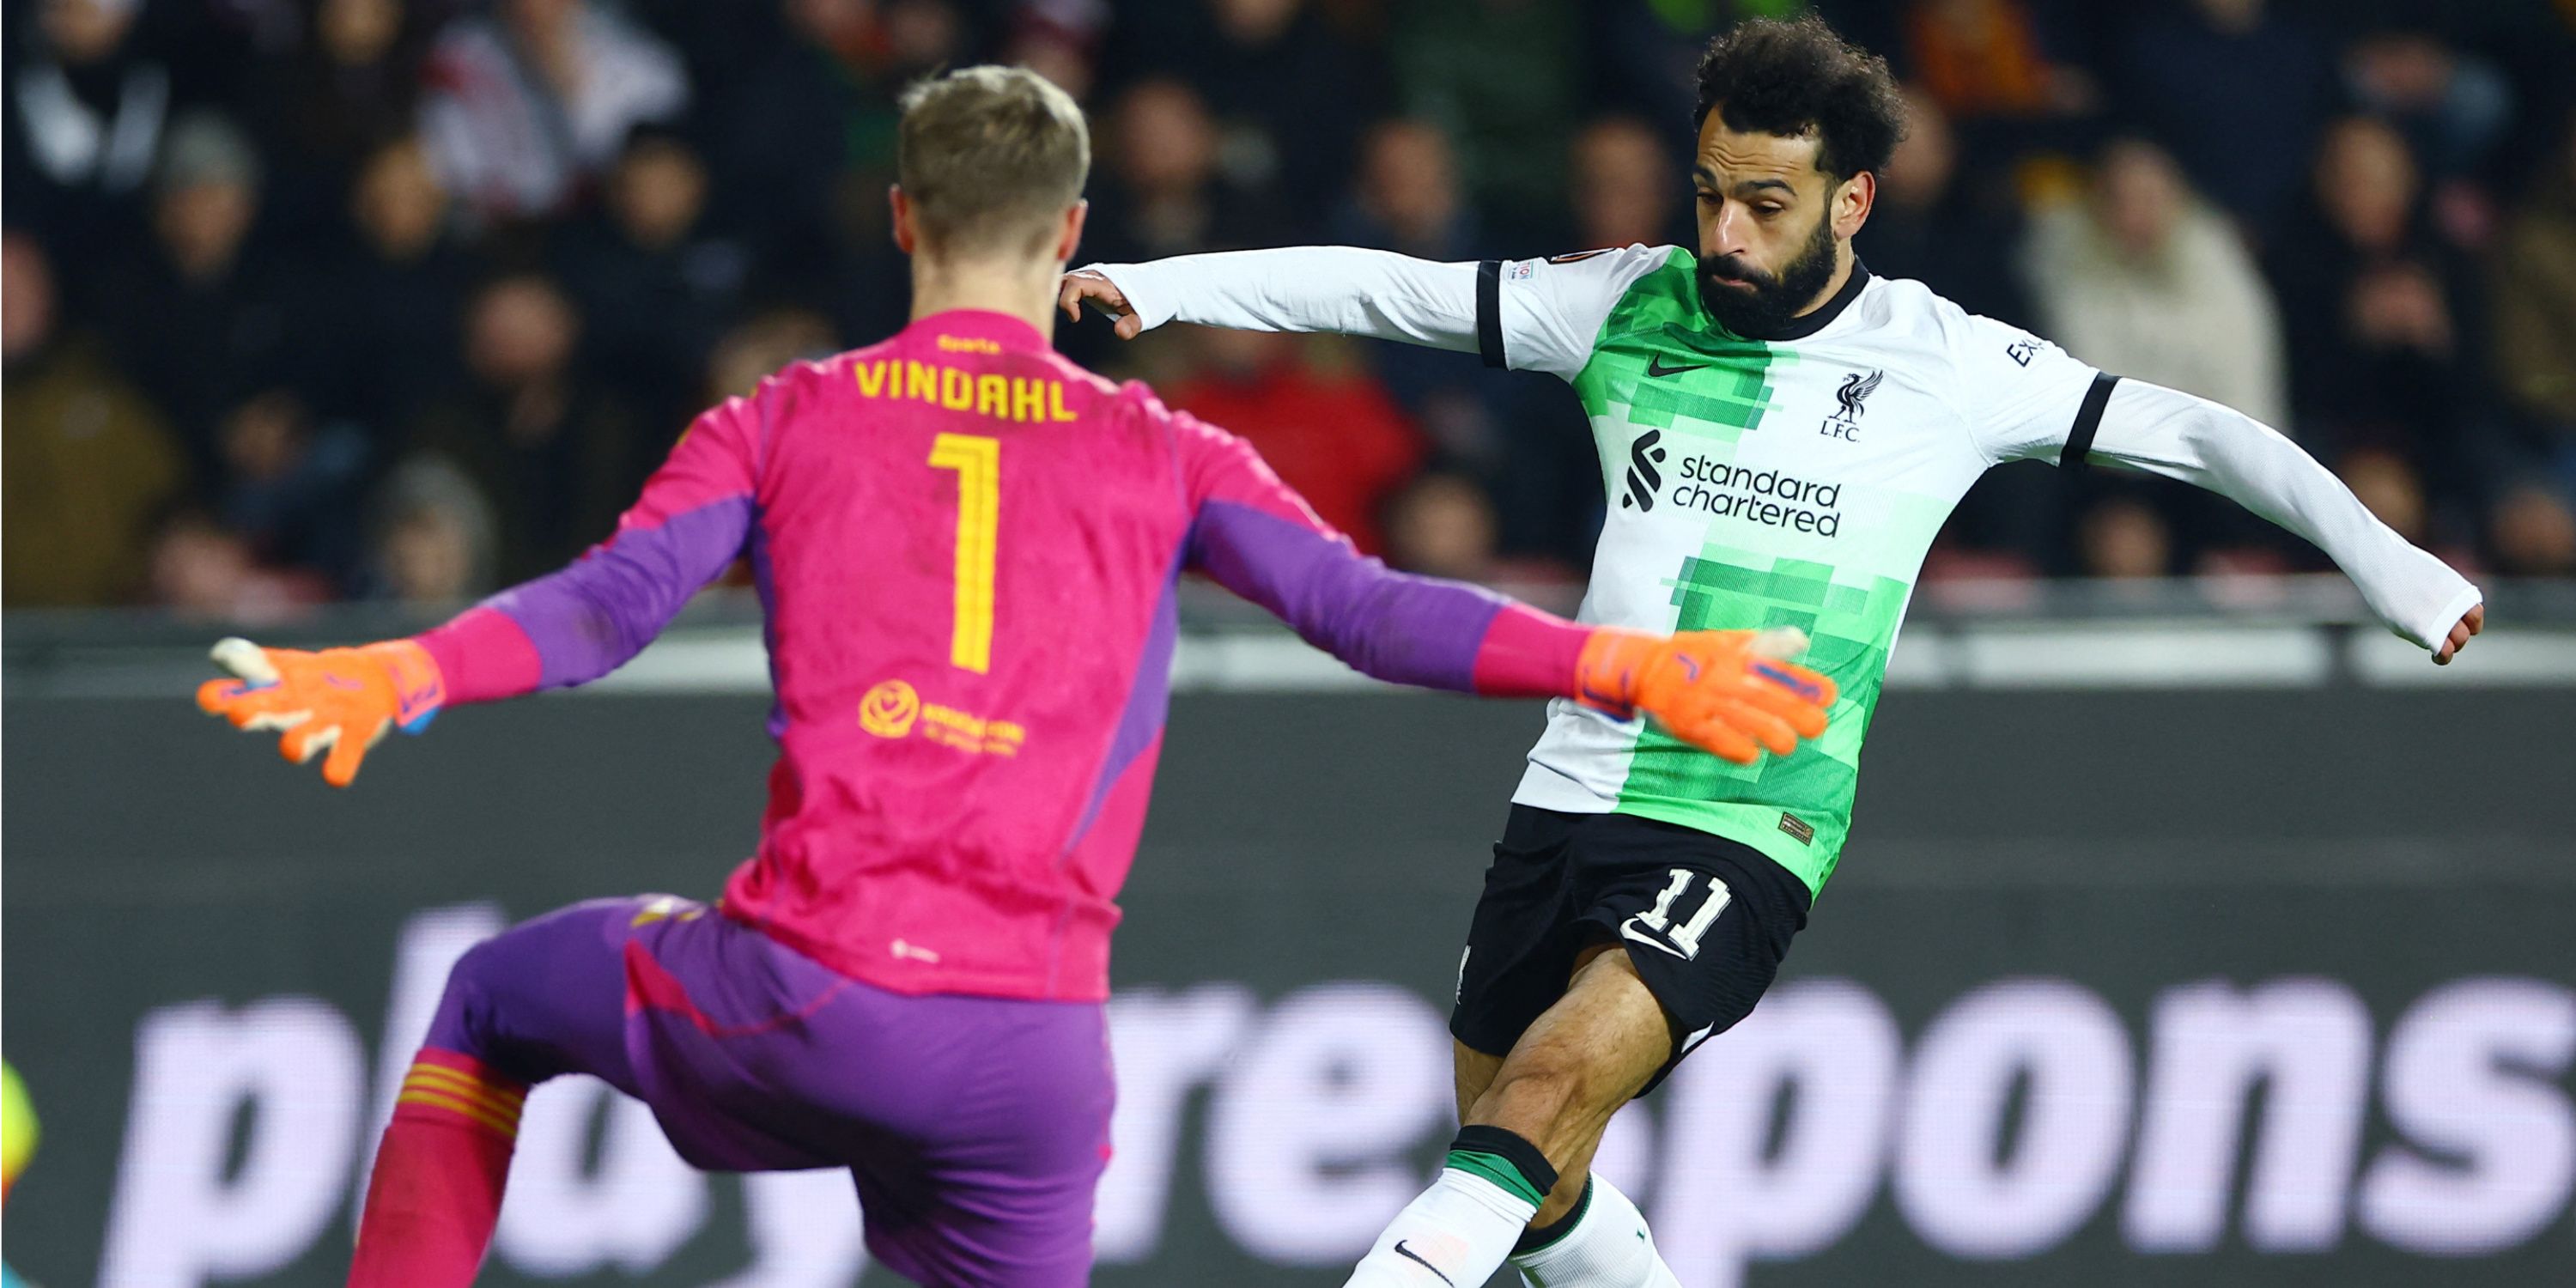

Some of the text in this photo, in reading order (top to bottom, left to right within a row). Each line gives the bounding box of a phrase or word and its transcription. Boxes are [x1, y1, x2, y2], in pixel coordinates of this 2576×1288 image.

[854, 359, 1078, 422] VINDAHL
[1672, 483, 1841, 538] chartered
[1680, 454, 1842, 508] standard
[927, 432, 1000, 675] 1
[1635, 868, 1732, 962] 11
[90, 898, 2576, 1288] pla repons
